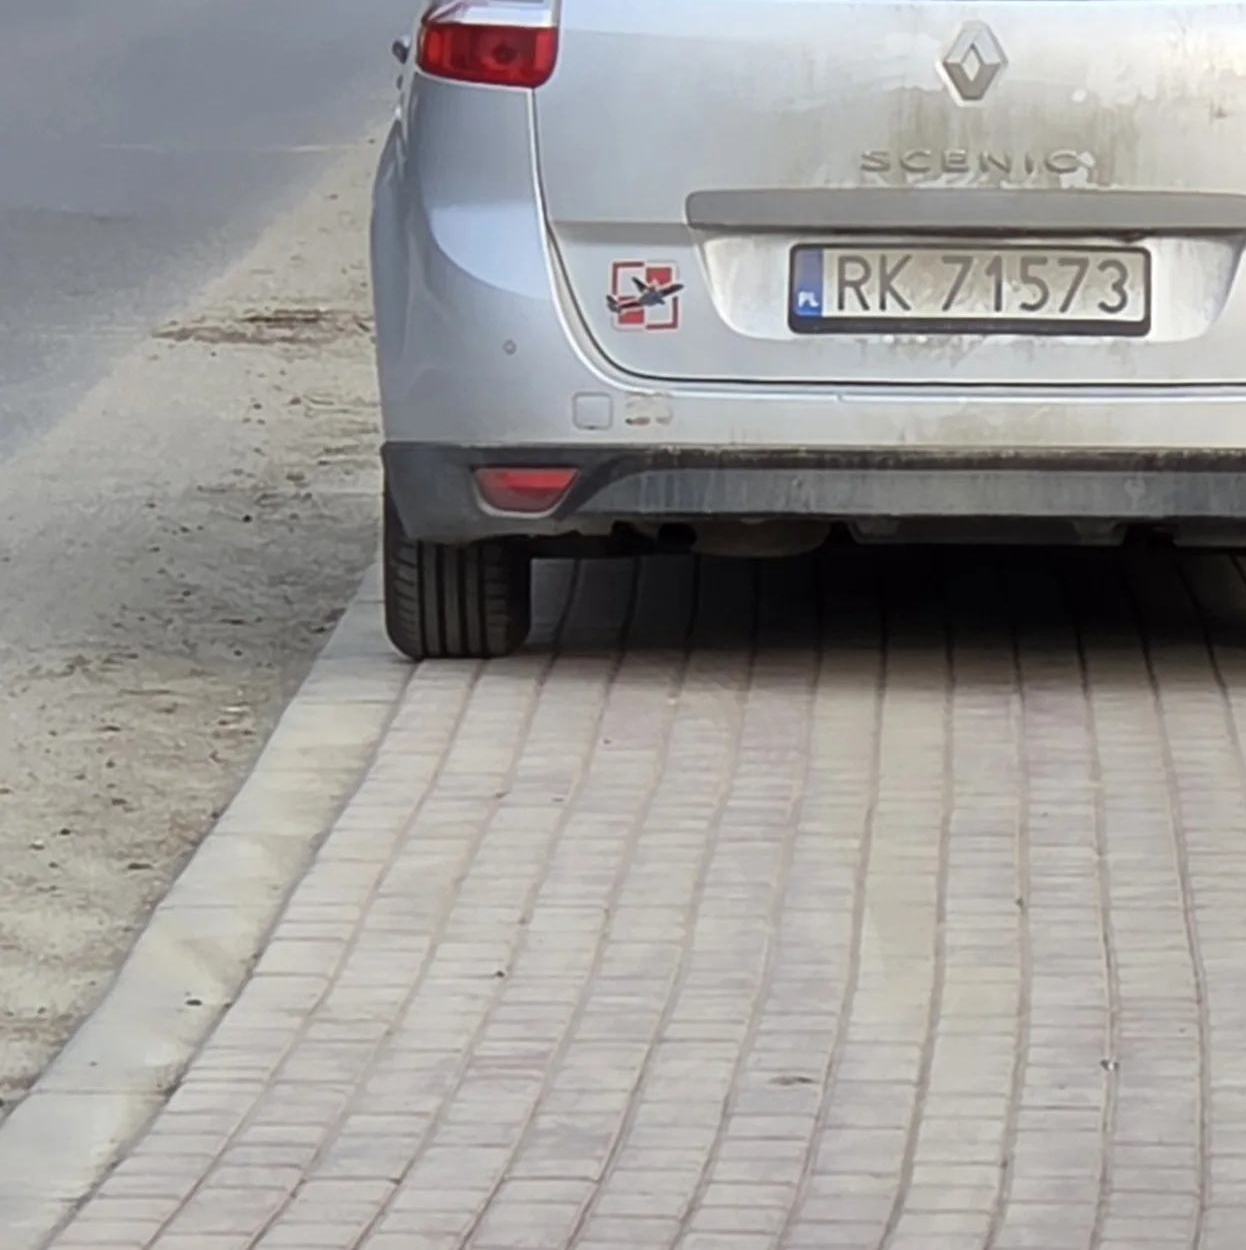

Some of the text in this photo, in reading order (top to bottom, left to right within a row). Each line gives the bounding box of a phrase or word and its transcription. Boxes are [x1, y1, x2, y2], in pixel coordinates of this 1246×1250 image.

[860, 149, 1086, 174] SCENIC
[837, 254, 1129, 314] RK 71573
